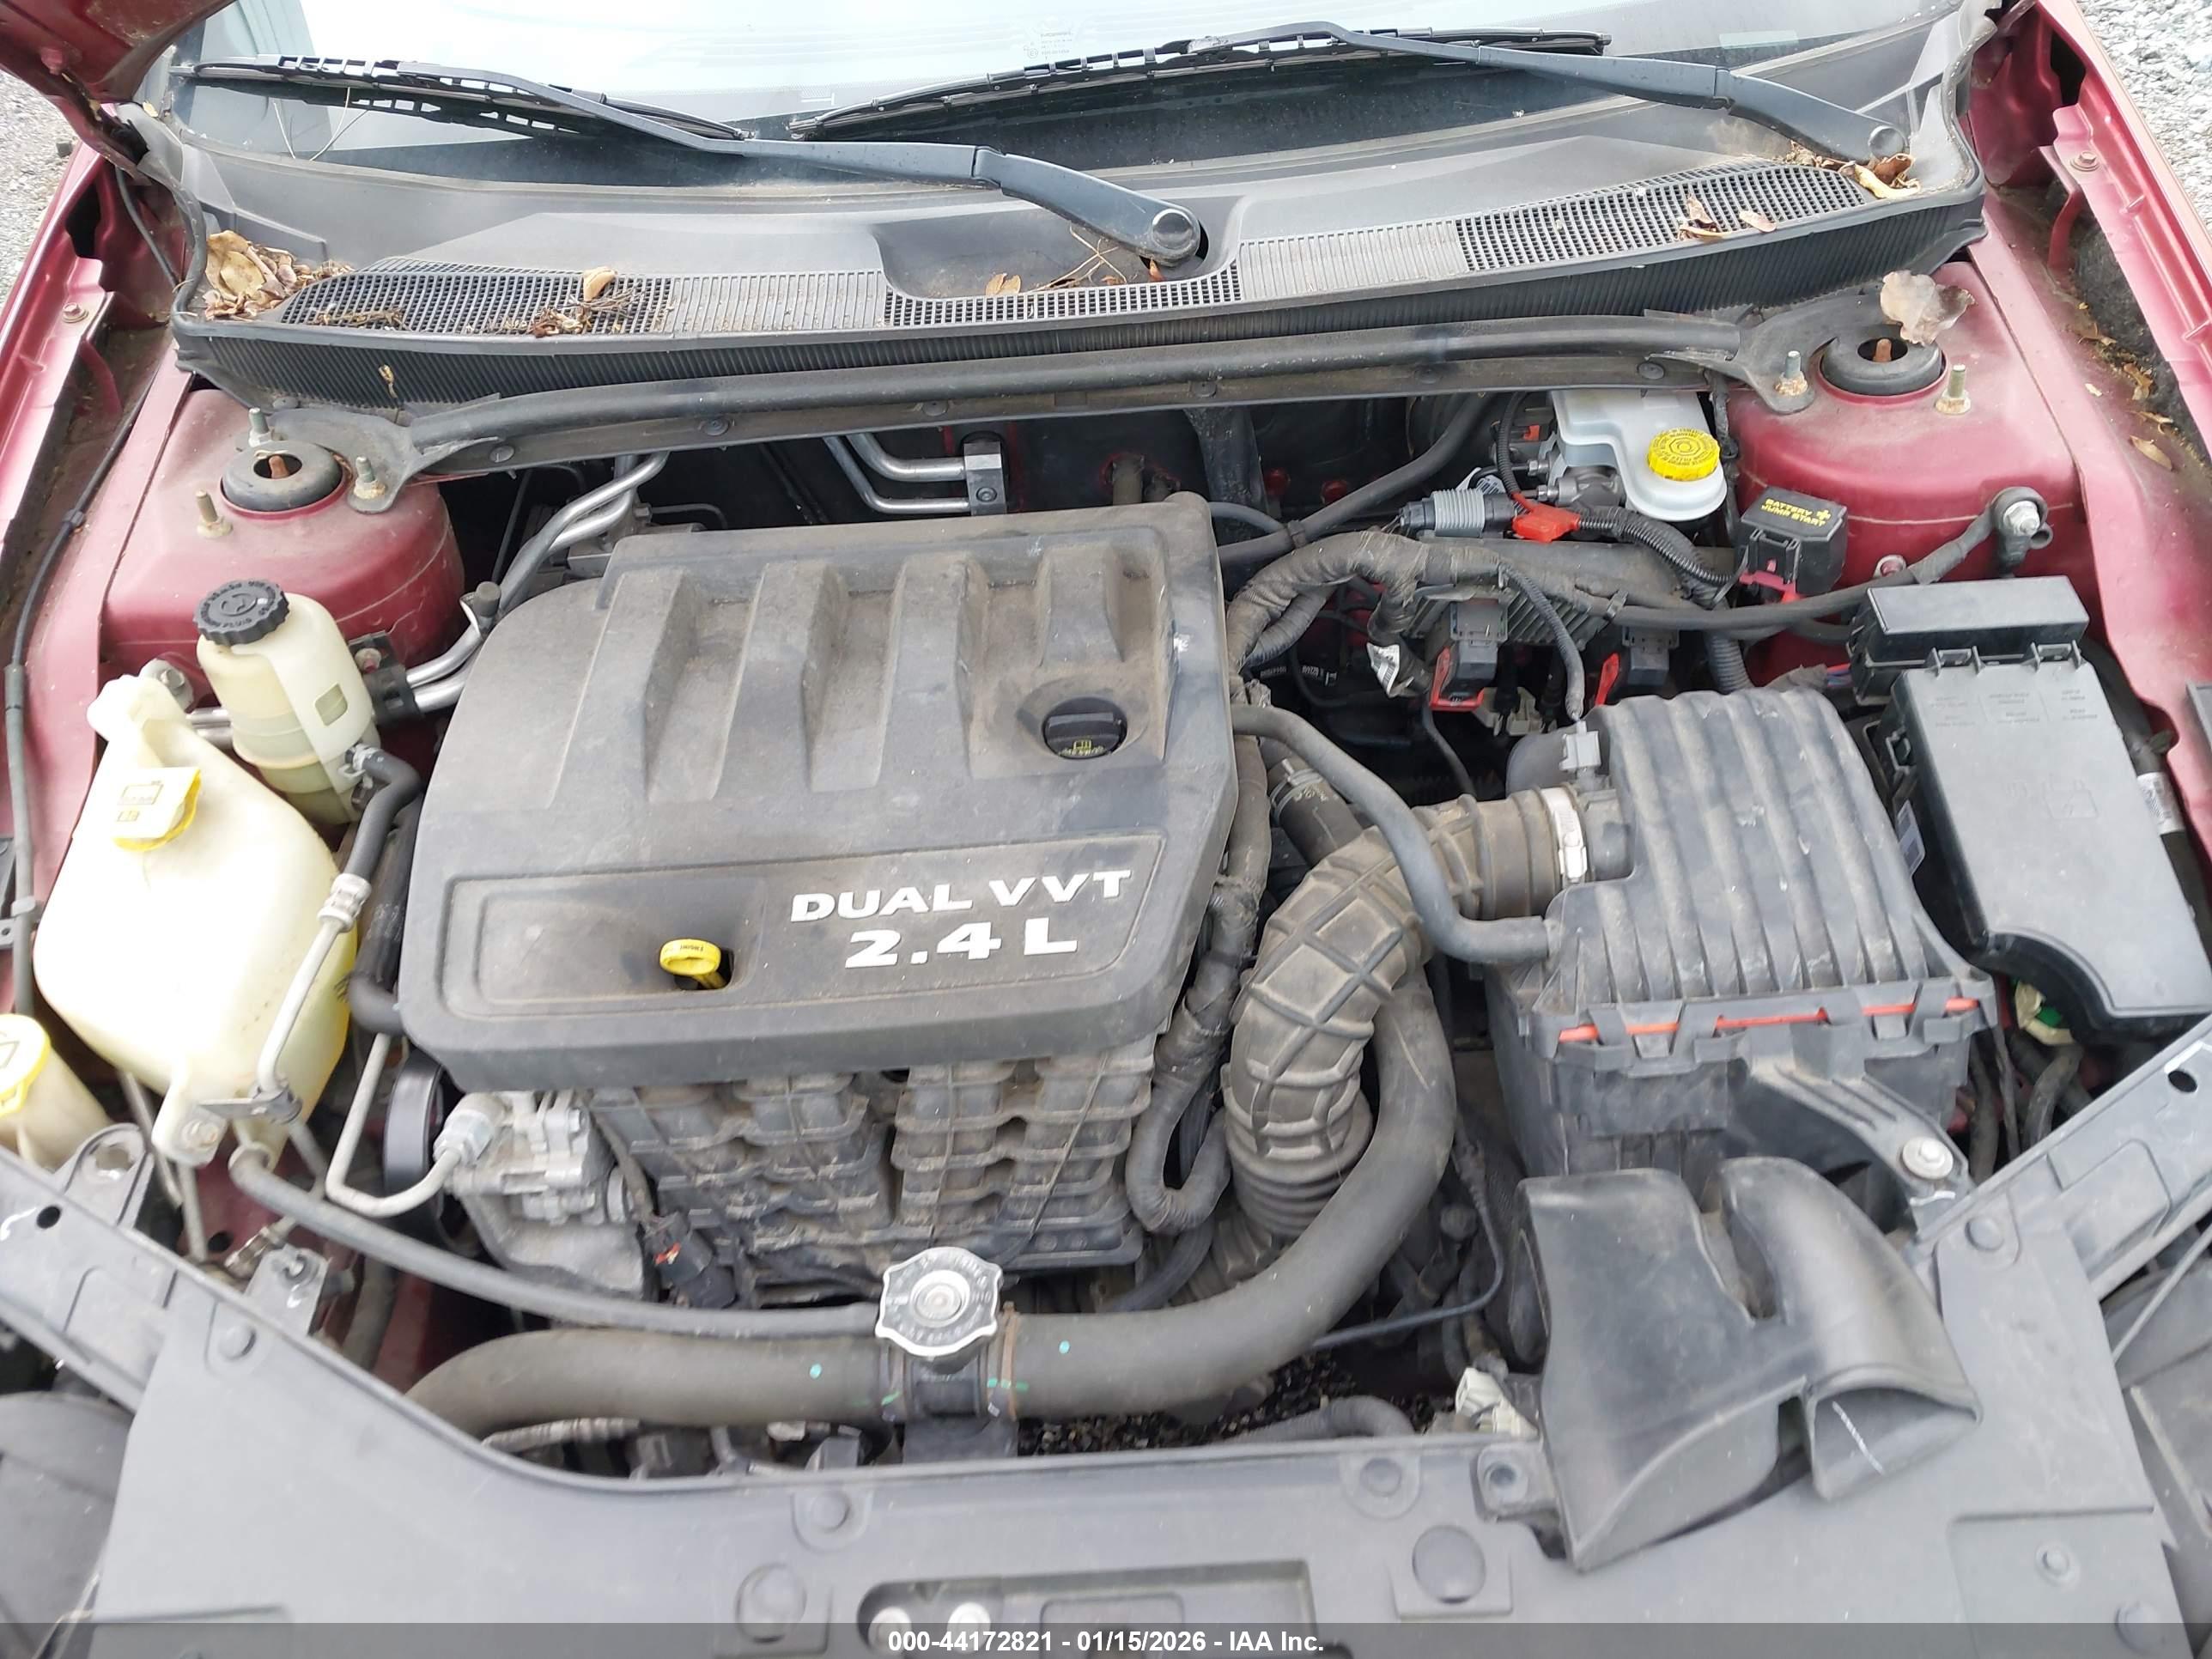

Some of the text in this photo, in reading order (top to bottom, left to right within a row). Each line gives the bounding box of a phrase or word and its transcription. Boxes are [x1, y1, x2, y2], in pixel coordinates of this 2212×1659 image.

[1761, 505, 1826, 526] JUMP START
[1765, 498, 1813, 515] BATTERY
[790, 870, 1132, 922] DUAL VVT
[845, 917, 1079, 969] 2.4 L
